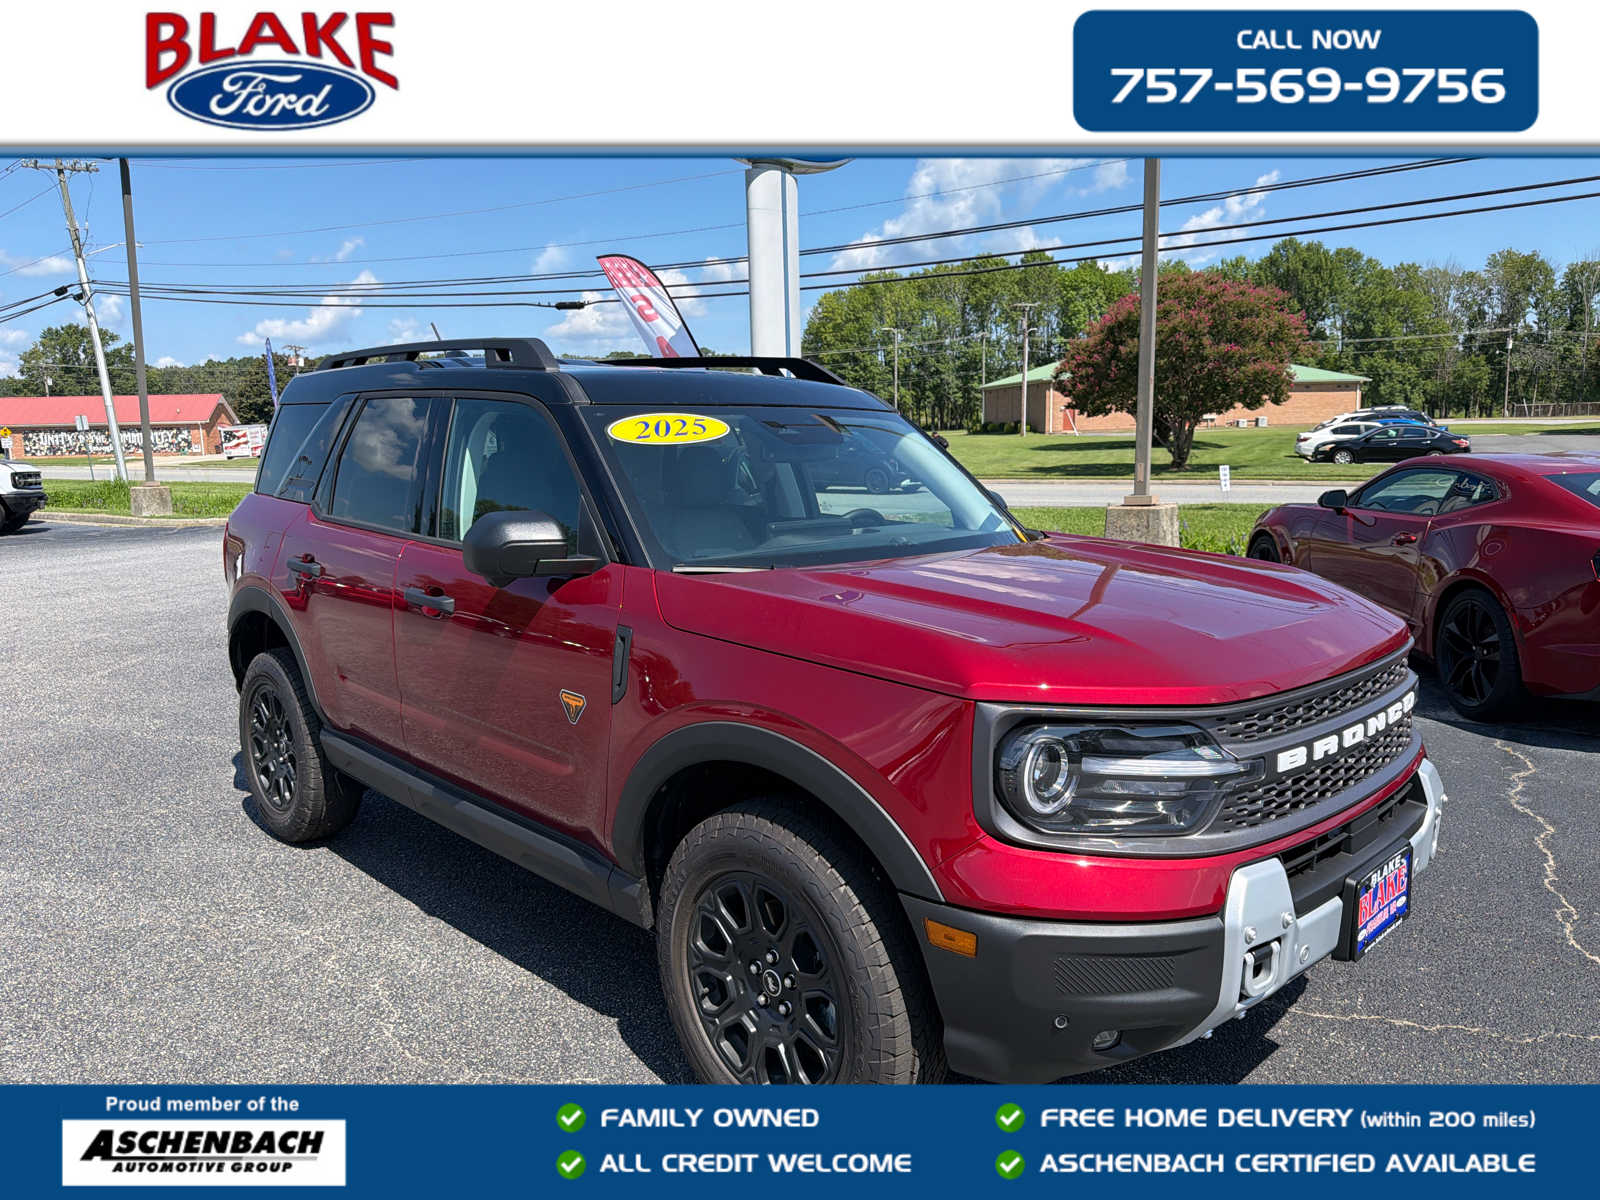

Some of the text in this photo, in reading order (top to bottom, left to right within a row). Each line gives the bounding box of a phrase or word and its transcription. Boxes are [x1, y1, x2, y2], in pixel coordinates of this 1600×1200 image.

[635, 418, 707, 440] 2025
[1277, 691, 1415, 773] BRONCO
[1358, 866, 1407, 928] BLAKE
